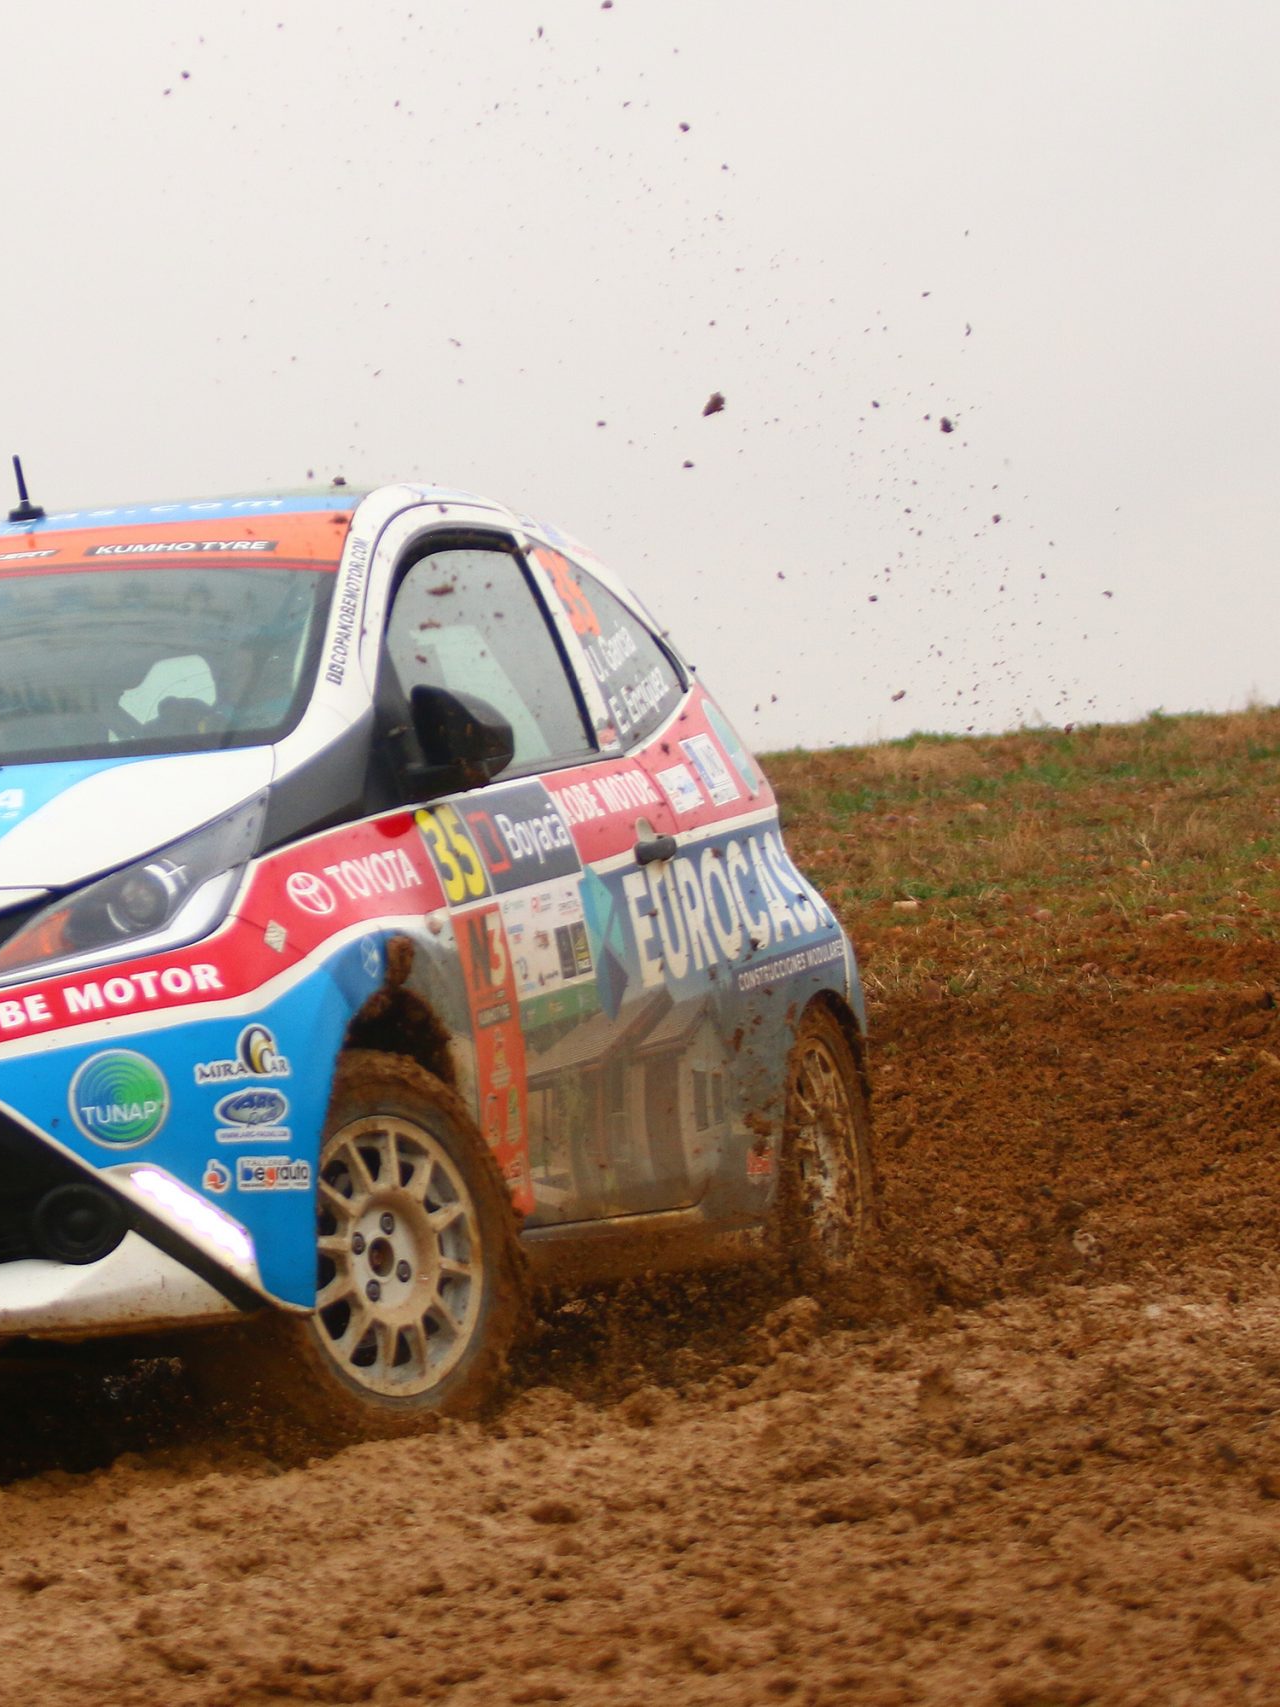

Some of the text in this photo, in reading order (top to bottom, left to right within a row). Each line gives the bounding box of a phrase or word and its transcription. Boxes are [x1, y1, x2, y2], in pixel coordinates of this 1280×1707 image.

[94, 540, 270, 556] KUMHO TYRE
[592, 769, 660, 814] MOTOR
[324, 848, 422, 900] TOYOTA
[415, 803, 486, 902] 35
[64, 964, 224, 1014] MOTOR
[81, 1100, 157, 1126] TUNAP
